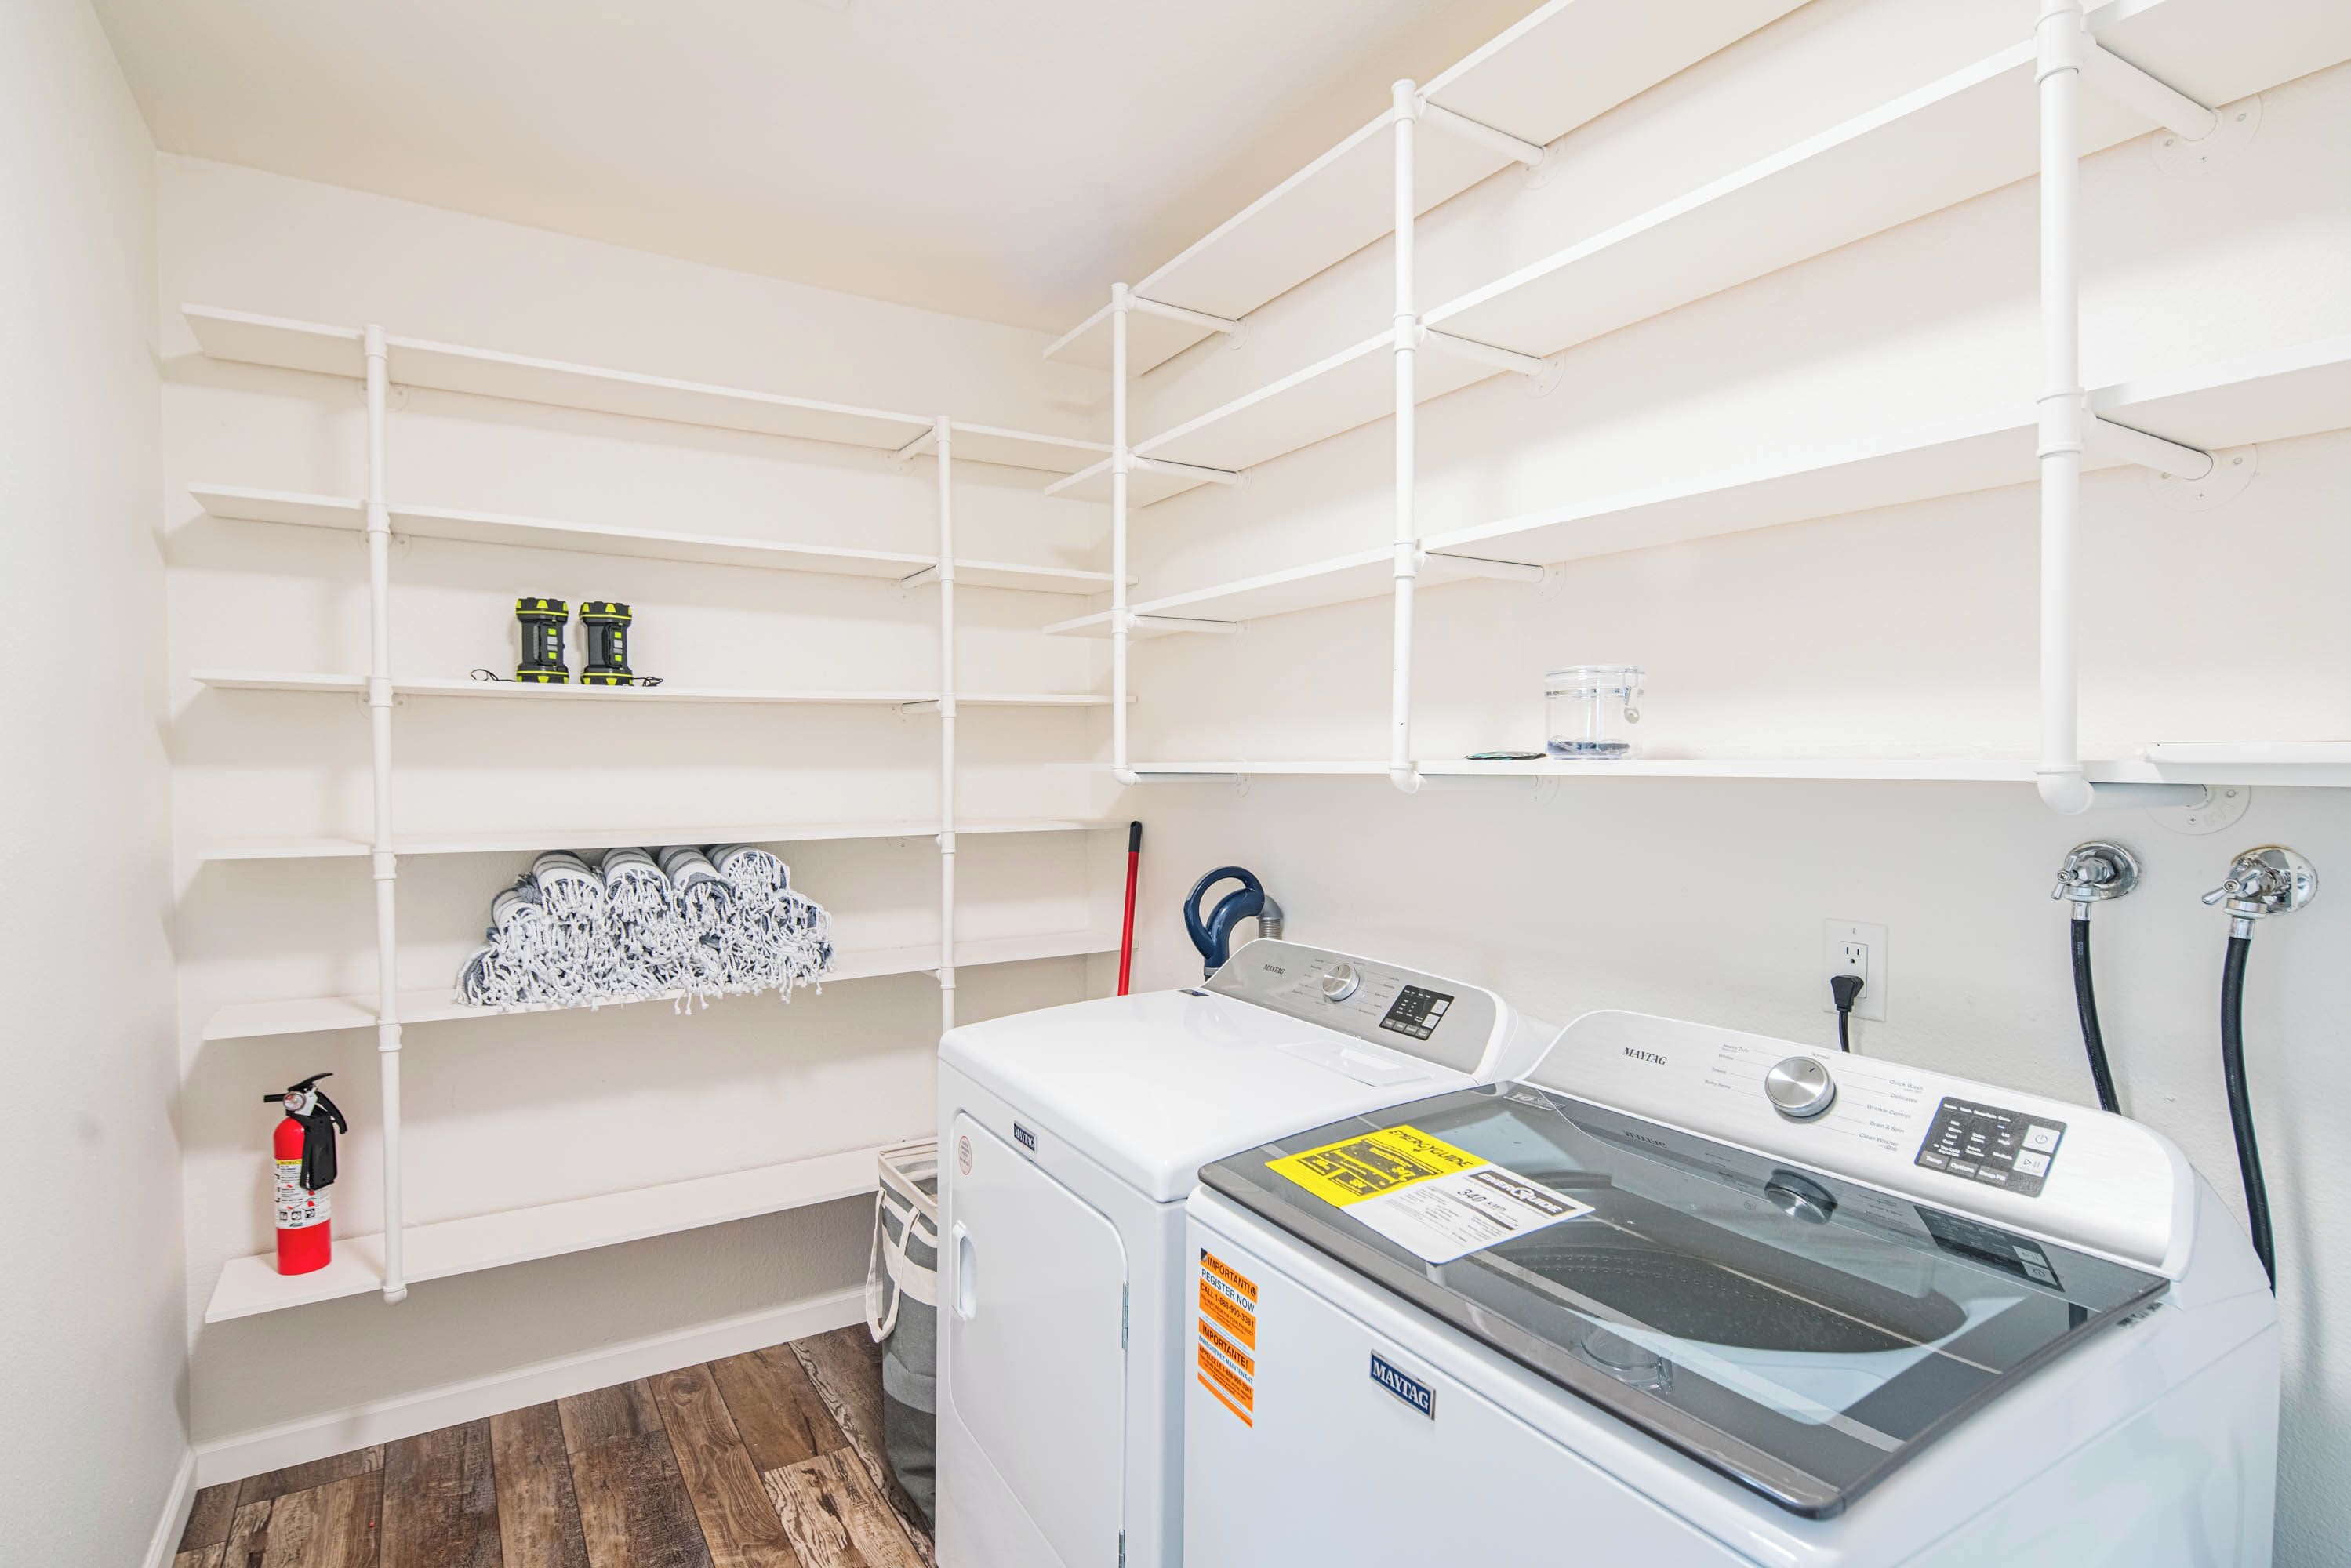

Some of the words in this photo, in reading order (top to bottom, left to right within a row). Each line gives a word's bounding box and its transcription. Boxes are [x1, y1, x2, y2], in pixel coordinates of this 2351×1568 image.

[1263, 964, 1285, 975] MAYTAG
[1622, 1047, 1668, 1065] MAYTAG
[1015, 1126, 1034, 1149] MAYTAG
[1457, 1188, 1487, 1203] 340
[1208, 1256, 1250, 1294] IMPORTANT!
[1201, 1268, 1235, 1300] REGISTER
[1237, 1294, 1255, 1313] NOW
[1201, 1283, 1214, 1298] CALL
[1202, 1323, 1248, 1369] IMPORTANTE!
[1226, 1359, 1253, 1385] MAINTENANT
[1372, 1359, 1428, 1410] MAYTAG
